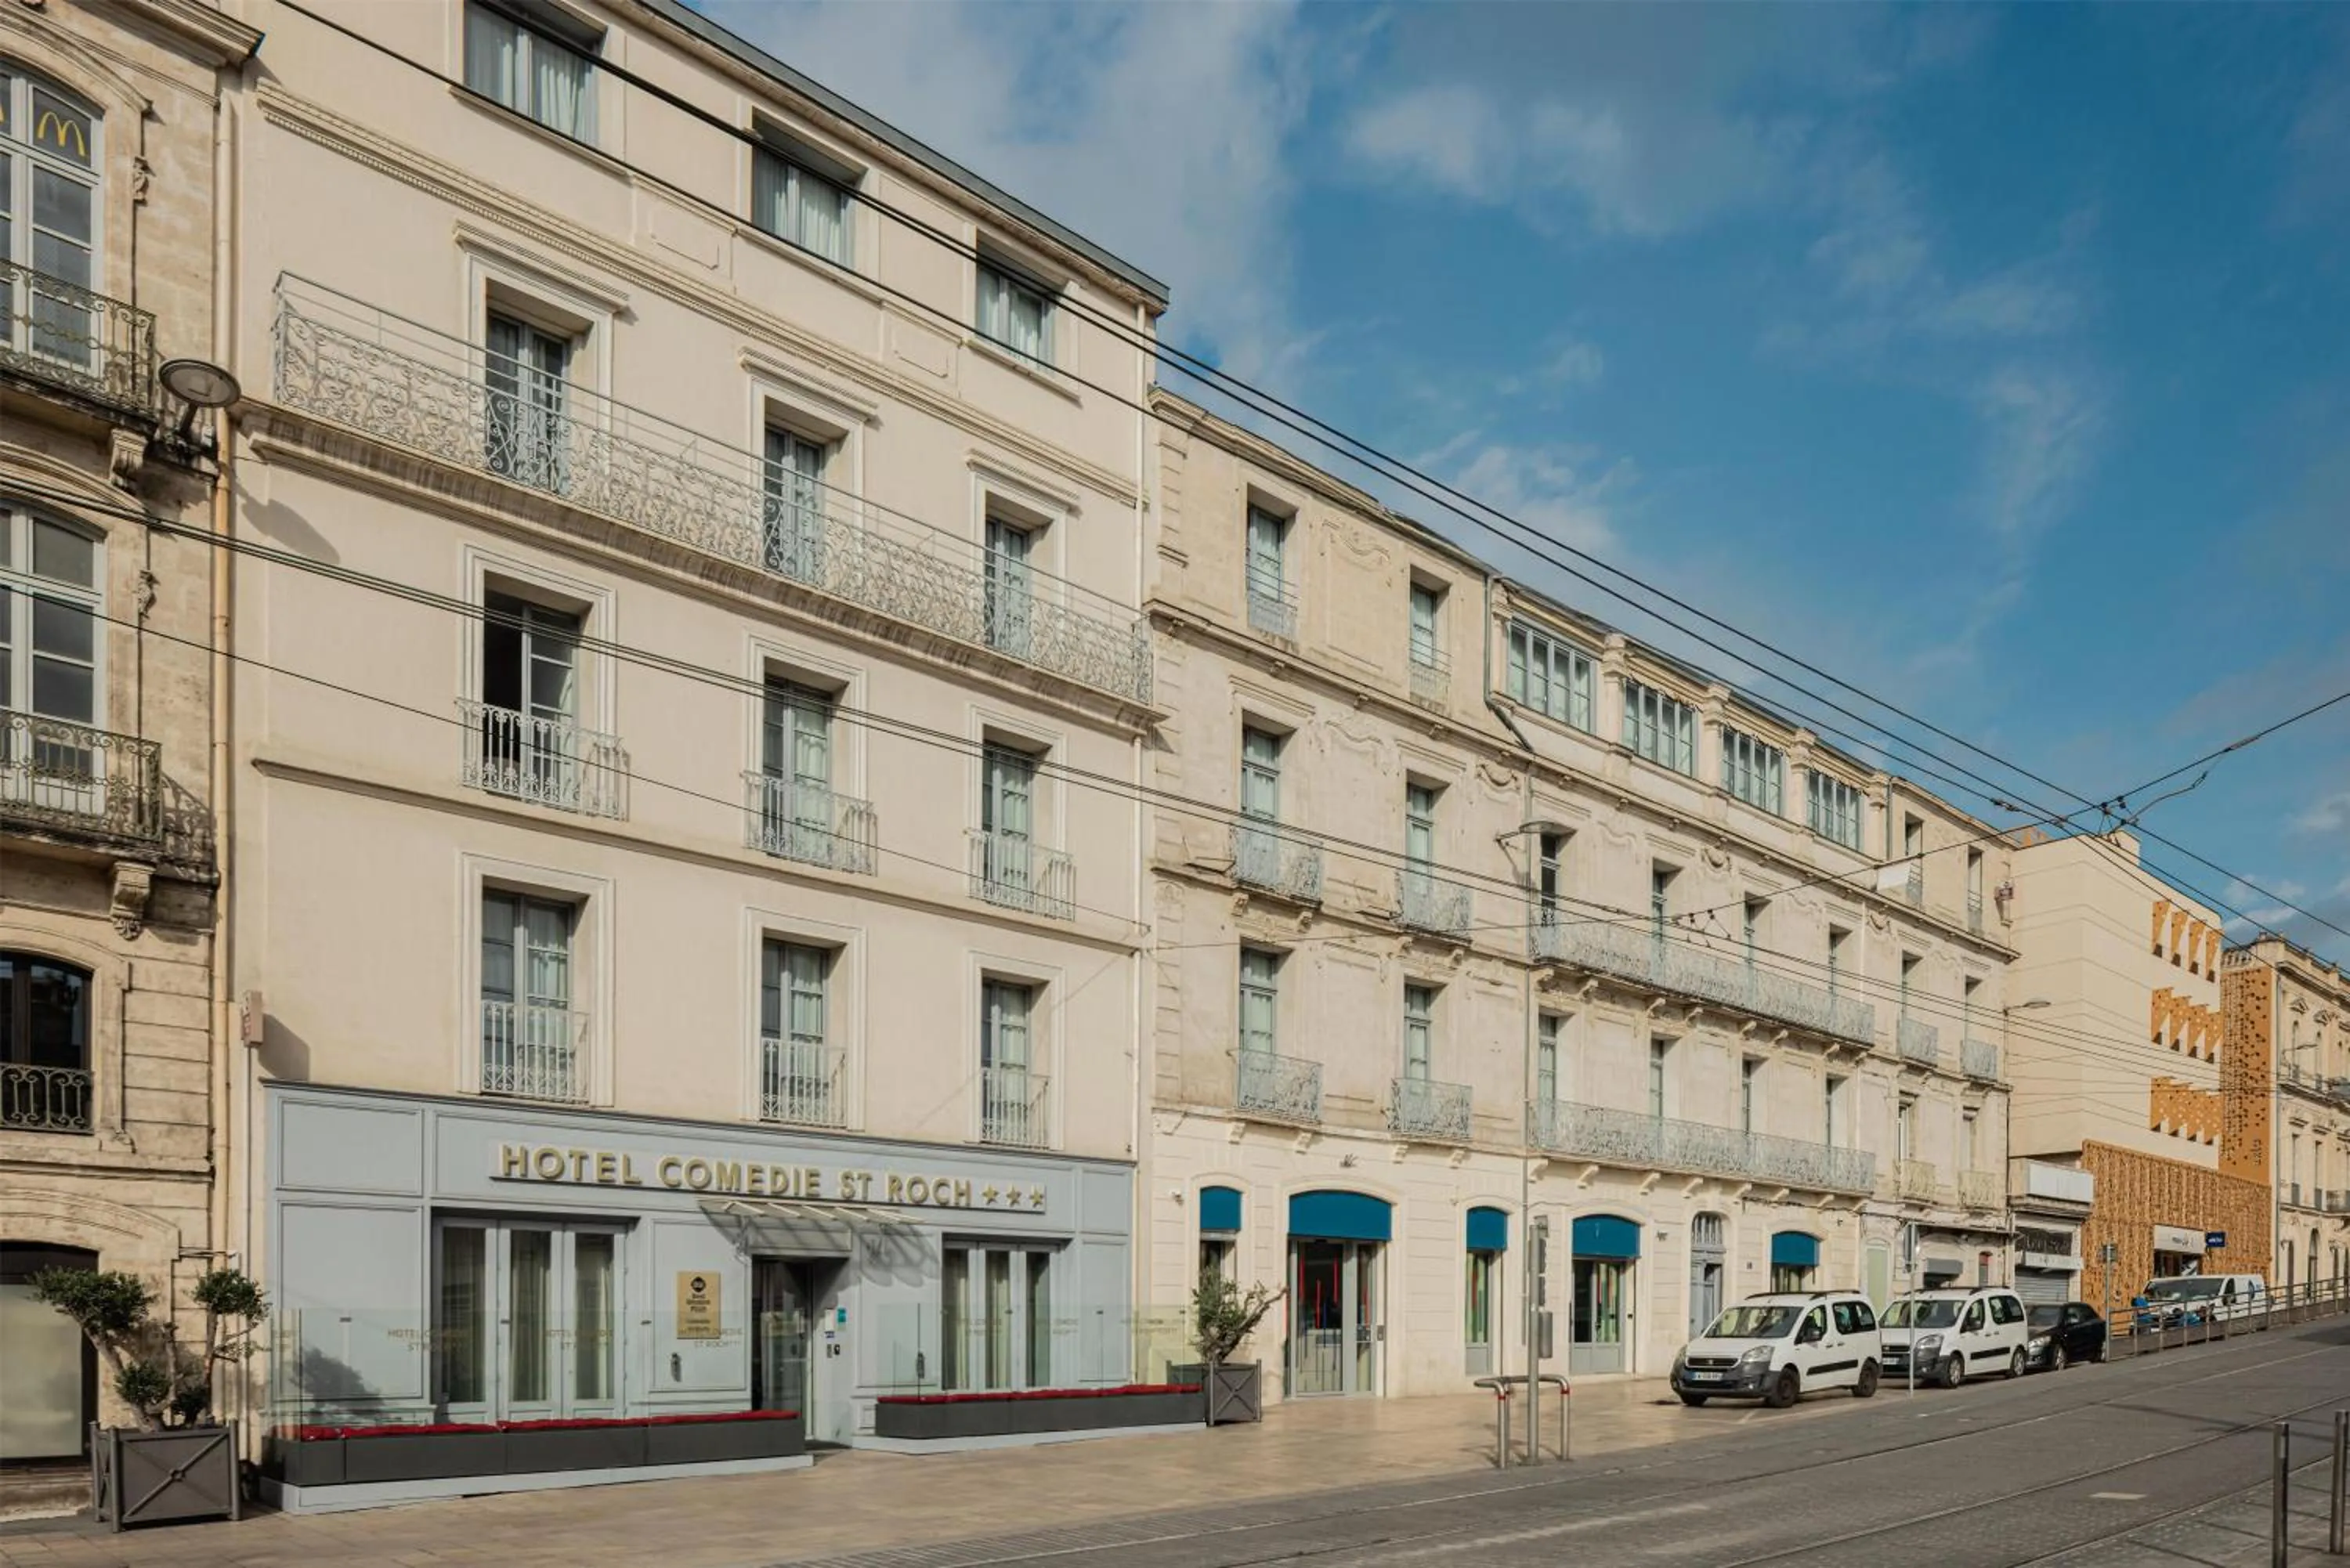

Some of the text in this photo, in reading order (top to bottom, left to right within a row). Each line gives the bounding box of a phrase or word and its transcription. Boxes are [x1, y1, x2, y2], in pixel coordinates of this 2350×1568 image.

[501, 1144, 972, 1207] HOTEL COMEDIE ST ROCH
